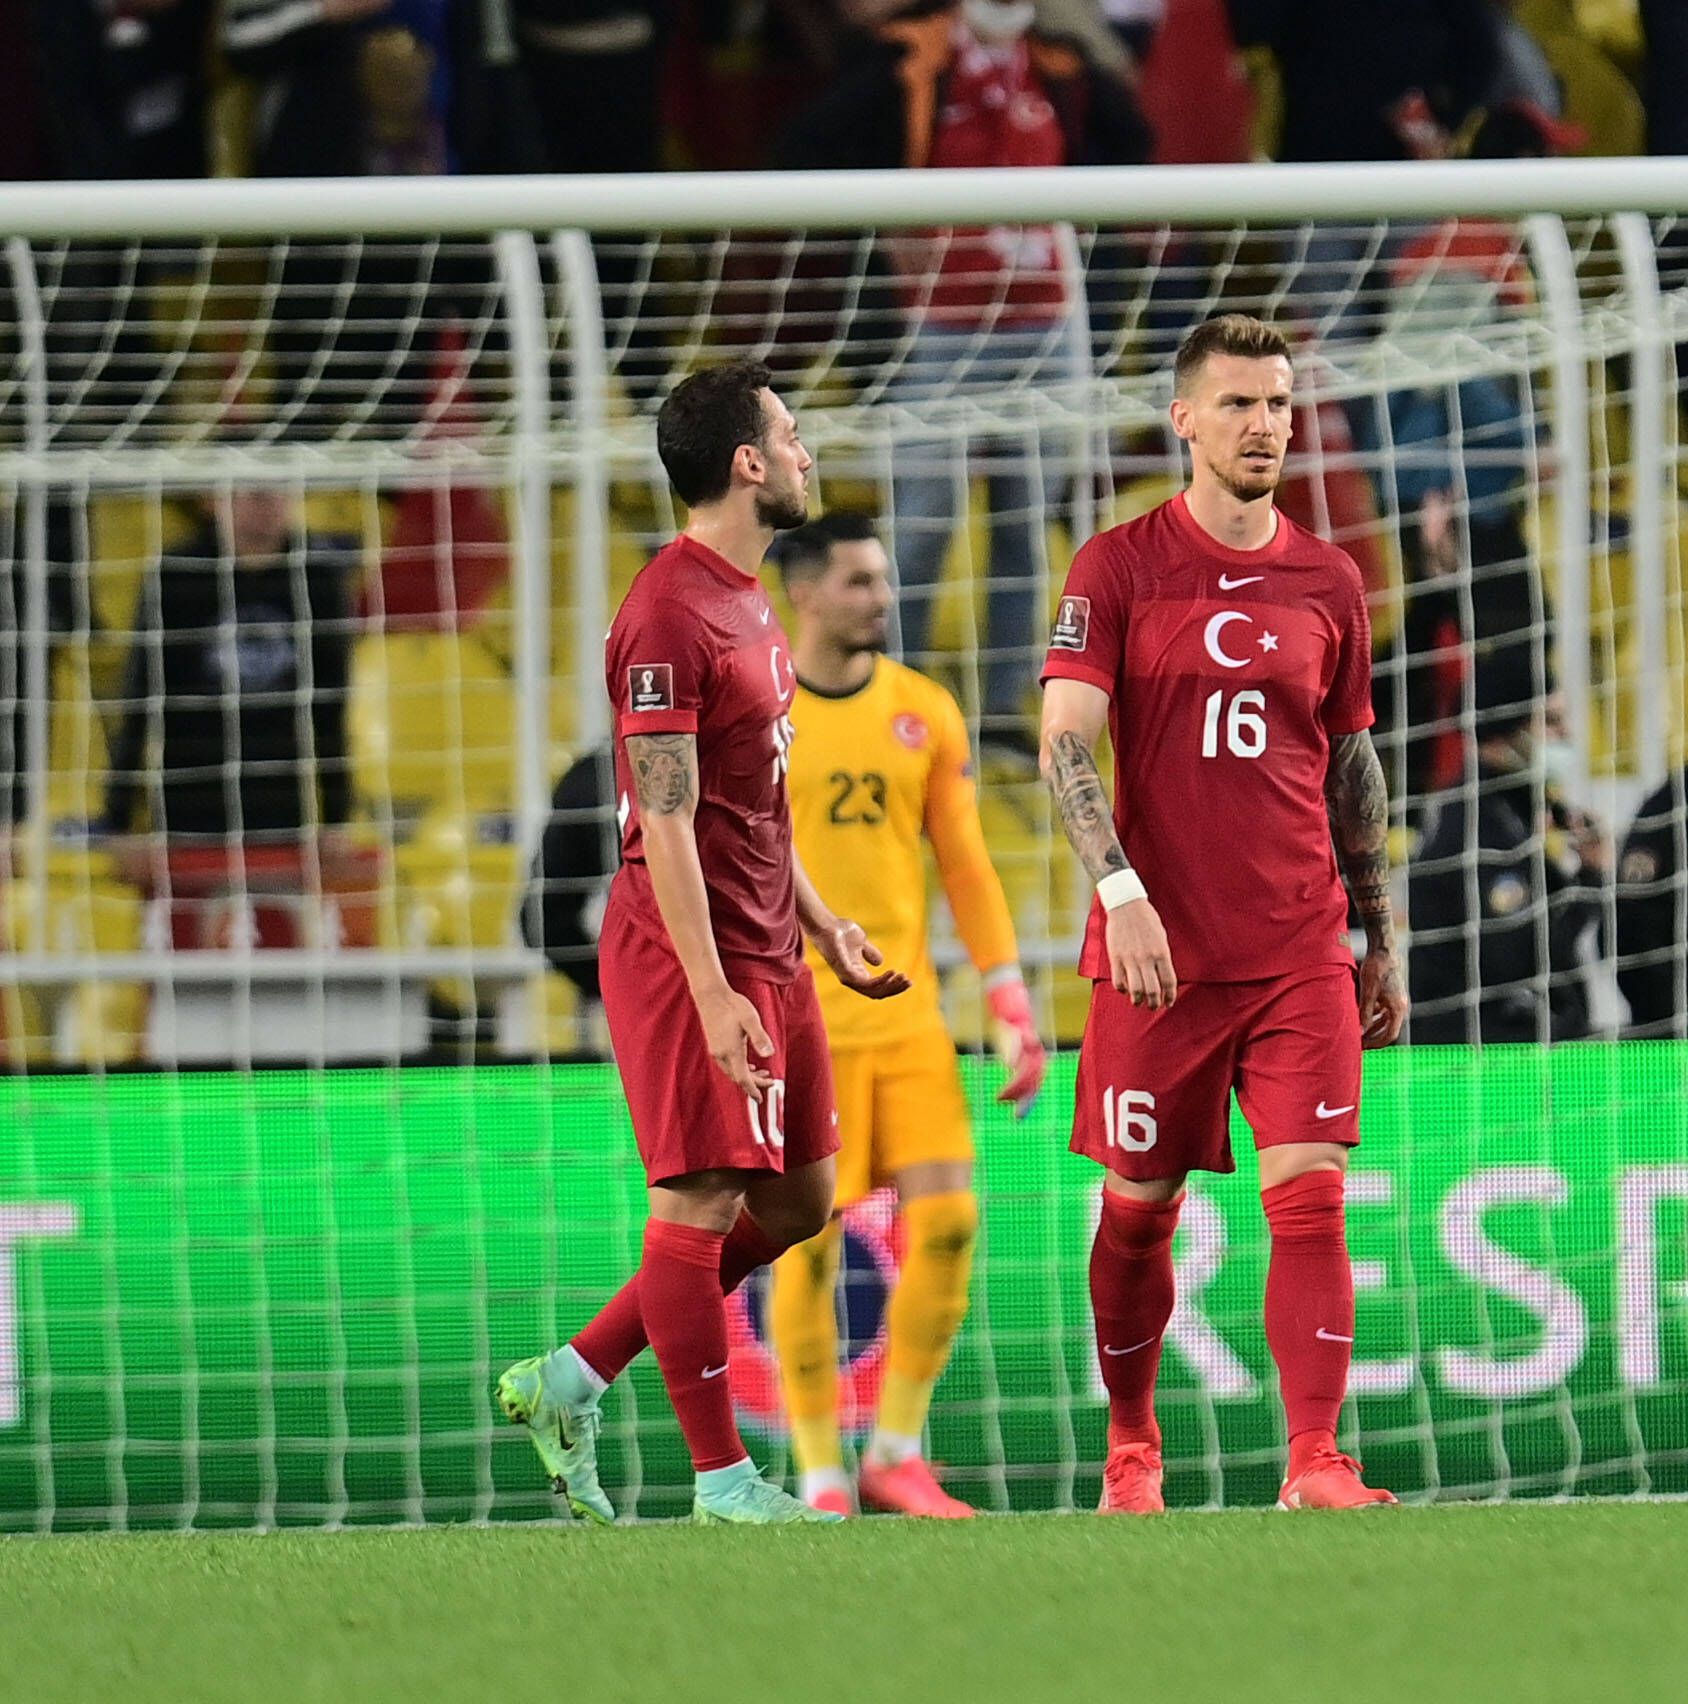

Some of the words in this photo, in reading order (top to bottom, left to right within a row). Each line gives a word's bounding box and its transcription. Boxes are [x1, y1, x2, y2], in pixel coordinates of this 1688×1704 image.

[1202, 689, 1267, 758] 16
[829, 769, 888, 826] 23
[747, 1078, 786, 1148] 10
[1103, 1084, 1158, 1152] 16
